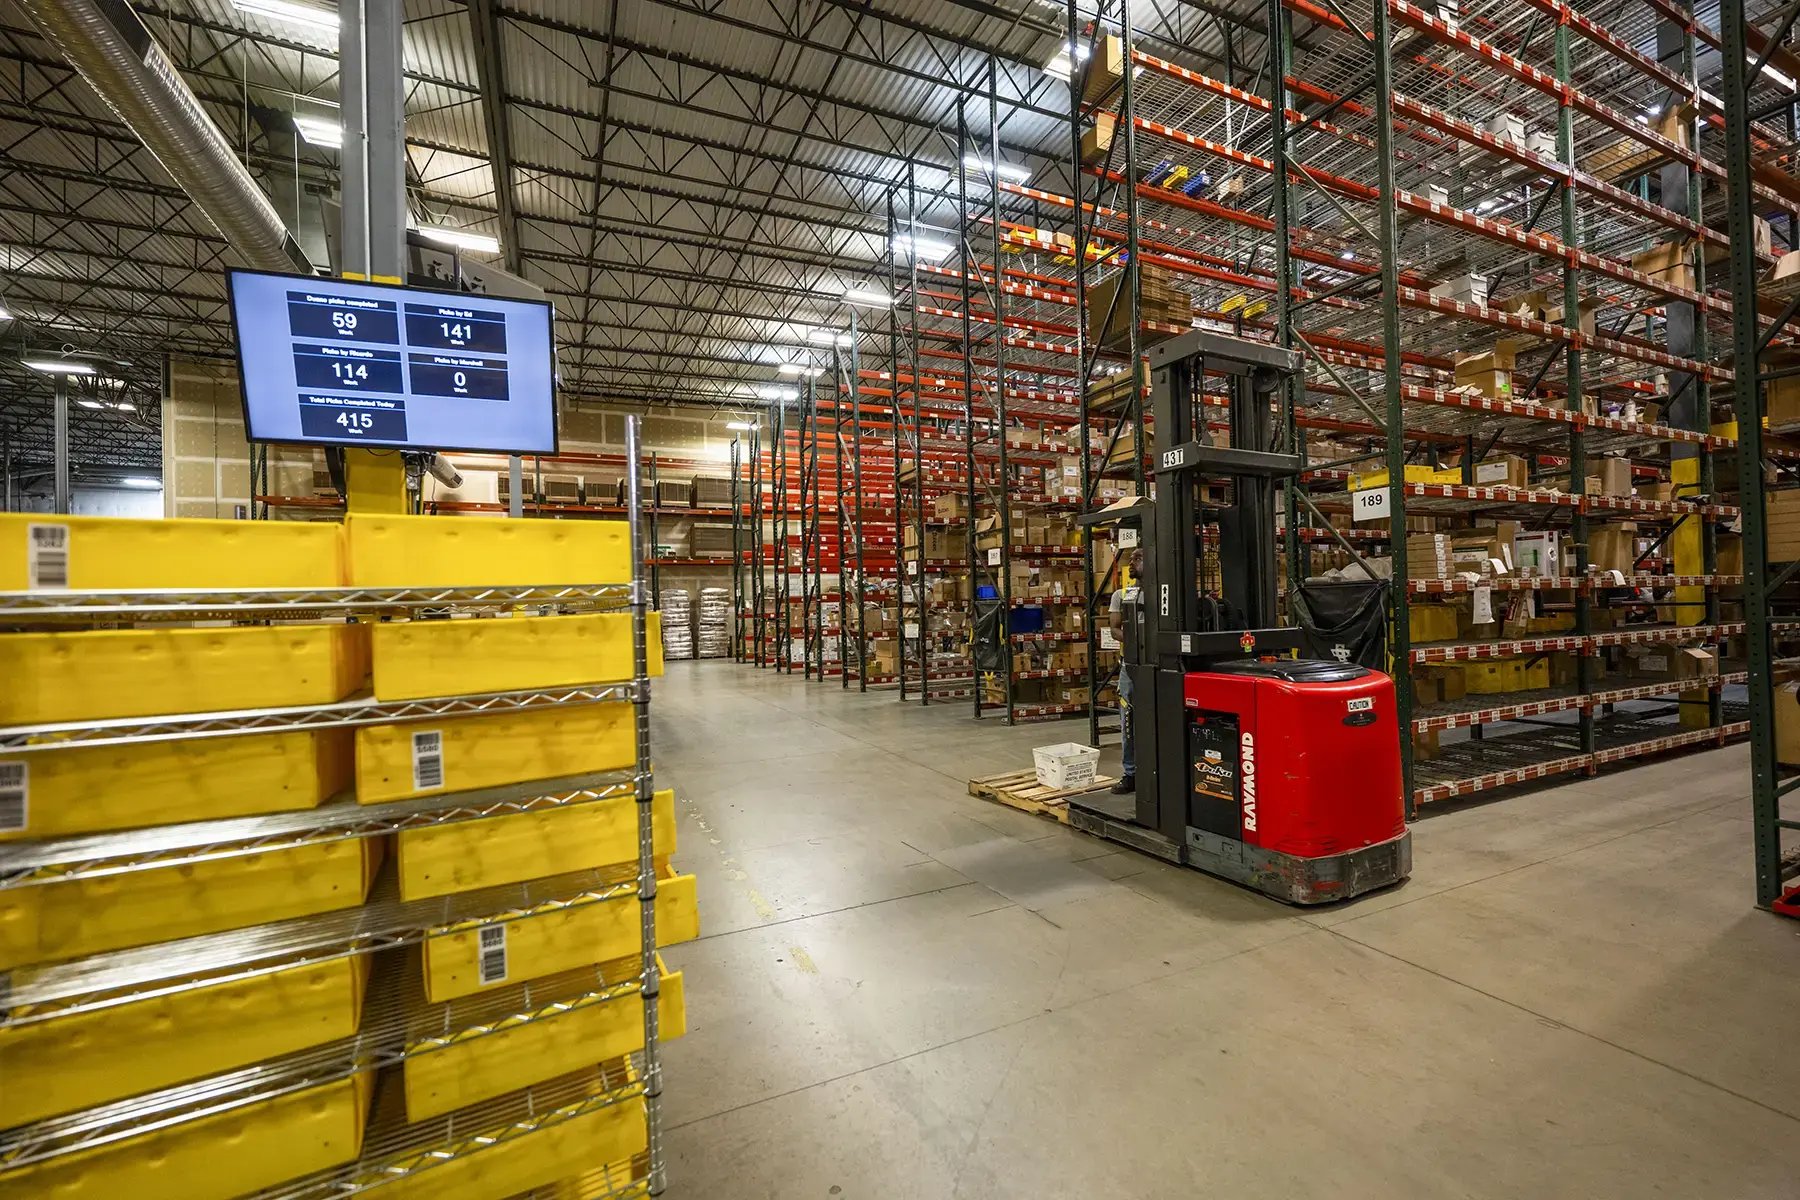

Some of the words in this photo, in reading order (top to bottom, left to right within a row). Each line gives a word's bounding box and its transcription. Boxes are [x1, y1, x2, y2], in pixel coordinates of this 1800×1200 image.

[328, 297, 346, 305] picks
[346, 300, 379, 308] completed
[438, 308, 455, 316] Picks
[332, 311, 357, 329] 59
[440, 322, 471, 339] 141
[321, 347, 339, 355] Picks
[339, 349, 349, 357] by
[349, 350, 374, 358] Ricardo
[433, 356, 451, 364] Picks
[331, 362, 368, 380] 114
[454, 371, 466, 387] 0
[309, 396, 325, 404] Total
[325, 397, 343, 405] Picks
[343, 398, 376, 407] Completed
[336, 412, 373, 428] 415
[1164, 449, 1183, 466] 43T
[1360, 494, 1383, 507] 189
[1122, 531, 1134, 541] 188
[1349, 700, 1370, 710] CAUTION
[1241, 732, 1257, 832] RAYMOND
